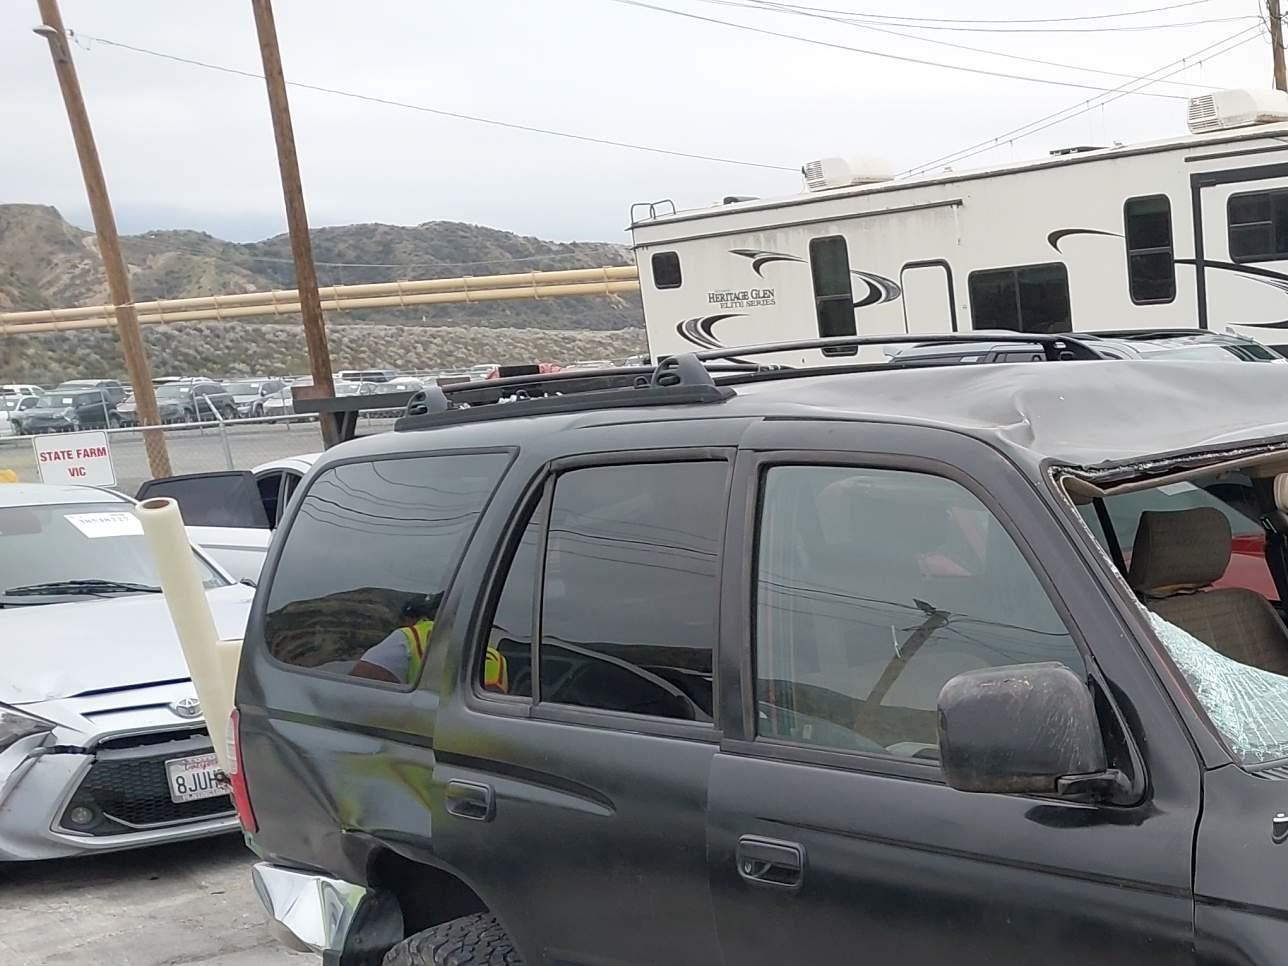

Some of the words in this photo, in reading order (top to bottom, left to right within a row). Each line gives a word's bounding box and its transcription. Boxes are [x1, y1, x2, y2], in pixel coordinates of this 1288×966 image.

[708, 291, 749, 303] HERITAGE
[750, 288, 775, 300] GLEN
[746, 299, 776, 307] SERIES
[40, 449, 73, 462] STATE
[76, 447, 107, 459] FARM
[68, 466, 87, 477] VIC
